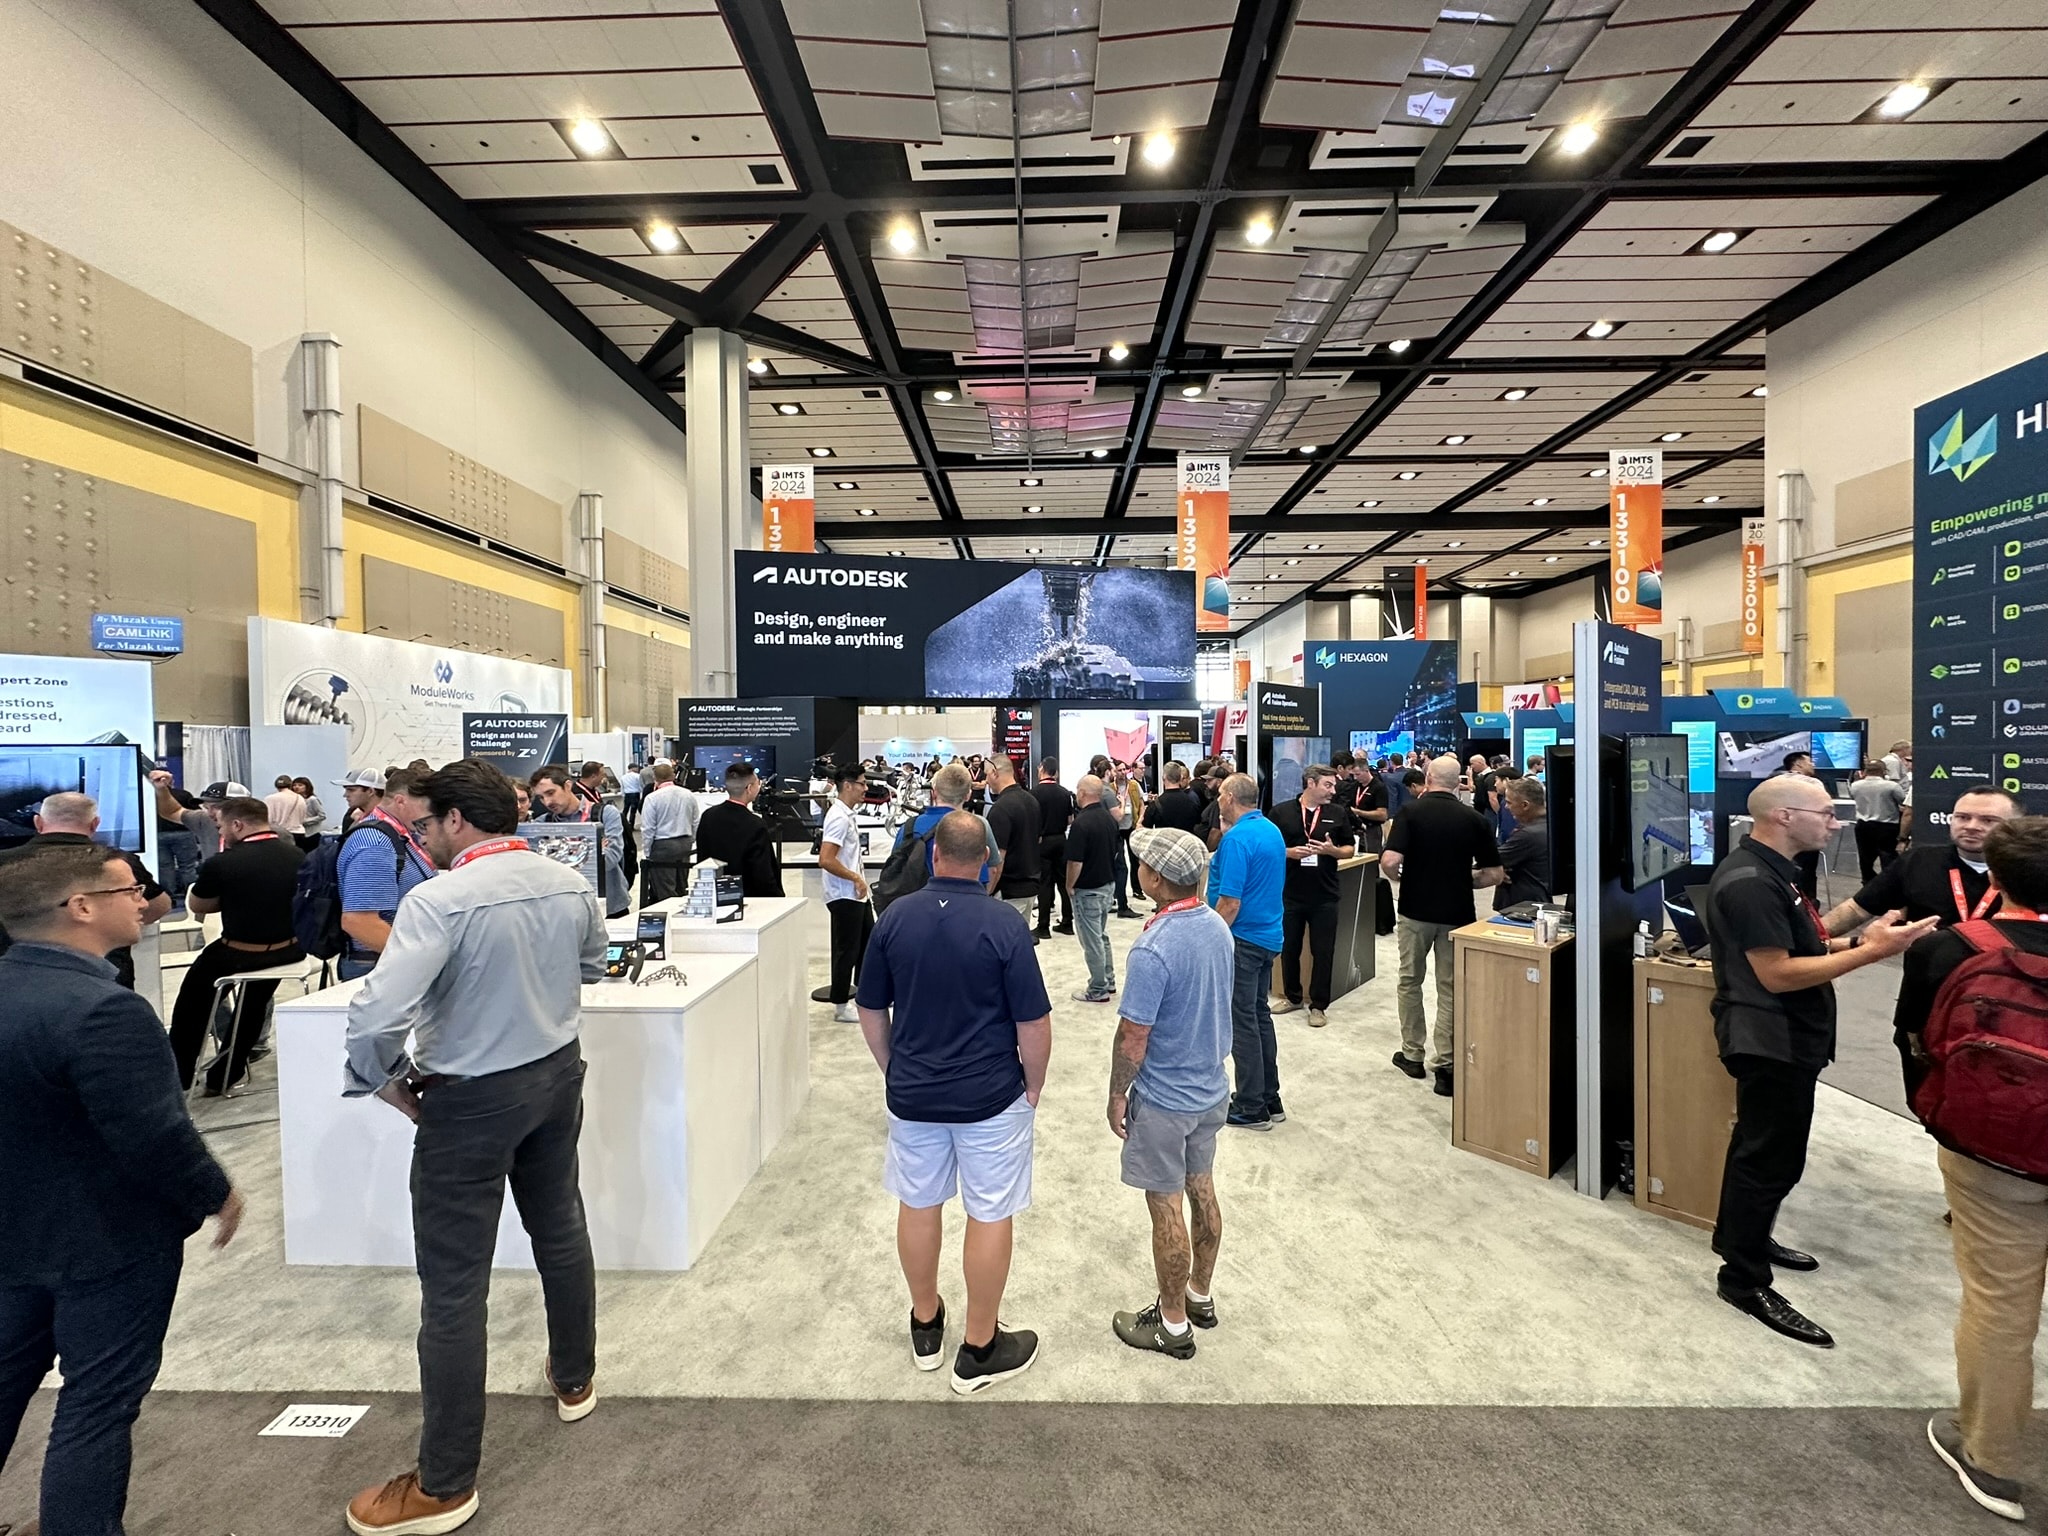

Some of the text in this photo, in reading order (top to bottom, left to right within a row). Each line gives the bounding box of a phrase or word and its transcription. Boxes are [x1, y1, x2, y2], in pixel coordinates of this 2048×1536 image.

[2016, 400, 2048, 439] H
[1630, 456, 1654, 464] IMTS
[1197, 463, 1220, 471] IMTS
[1618, 466, 1654, 477] 2024
[1186, 472, 1220, 484] 2024
[772, 480, 806, 491] 2024
[1931, 494, 2034, 534] Empowering
[1614, 493, 1630, 604] 133100
[783, 568, 908, 588] AUTODESK
[1745, 550, 1757, 636] 133000
[110, 615, 149, 624] Mazak
[754, 611, 887, 629] Design, engineer
[105, 627, 170, 638] CAMLINK
[754, 631, 904, 649] and make anything
[117, 642, 154, 651] Mazak
[1340, 652, 1388, 663] HEXAGON
[34, 677, 68, 686] Zone
[410, 684, 474, 700] ModuleWorks
[484, 720, 548, 728] AUTODESK
[470, 732, 498, 740] Design
[470, 740, 511, 748] Challenge
[288, 1415, 352, 1428] 133310
